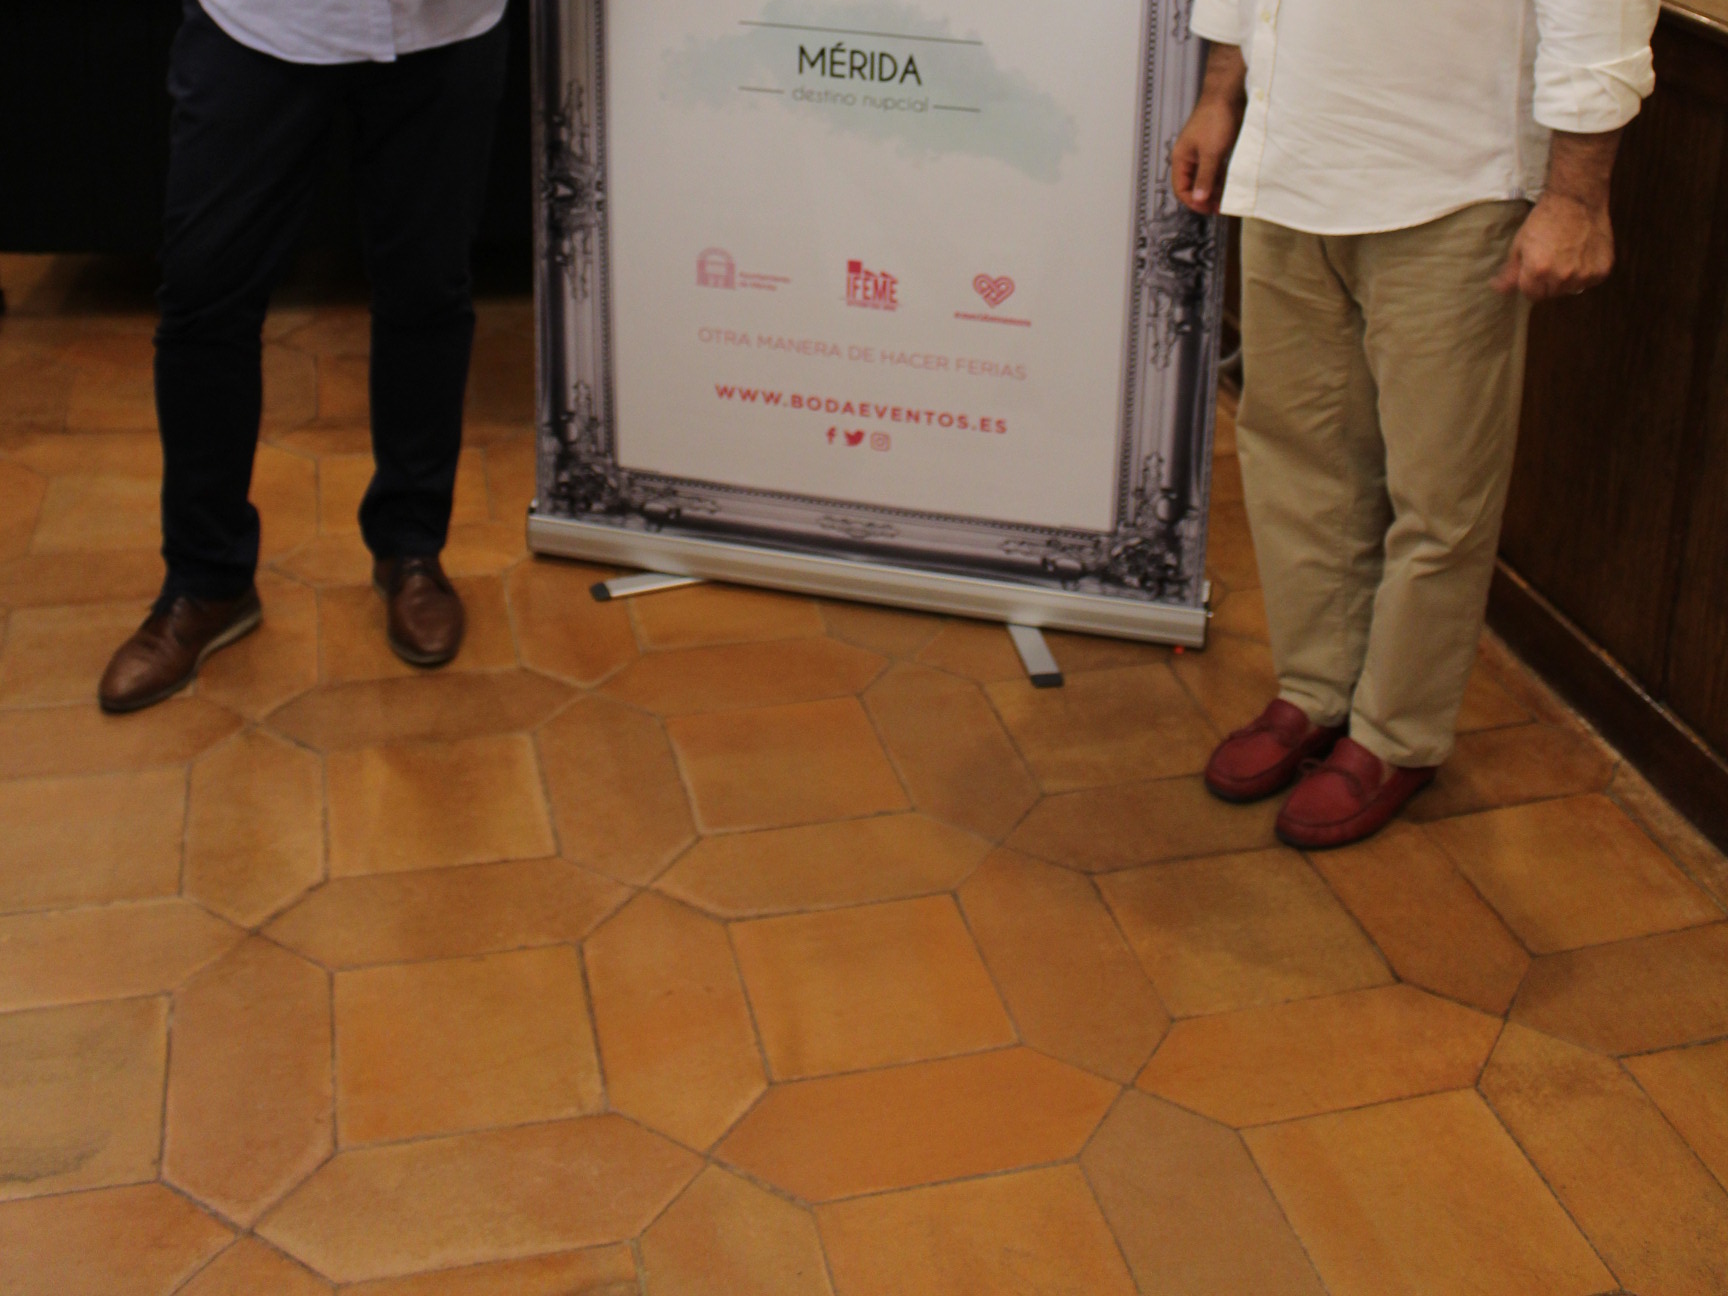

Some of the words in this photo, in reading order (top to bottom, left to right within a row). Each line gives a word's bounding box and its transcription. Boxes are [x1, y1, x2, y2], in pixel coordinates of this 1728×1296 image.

[798, 41, 923, 86] MÉRIDA
[791, 86, 857, 107] destino
[862, 94, 929, 113] nupcial
[698, 326, 751, 348] OTRA
[756, 334, 842, 360] MANERA
[847, 345, 876, 364] DE
[879, 349, 949, 372] HACER
[955, 356, 1027, 382] FERIAS
[714, 383, 1008, 434] WWW.BODAEVENTOS.ES
